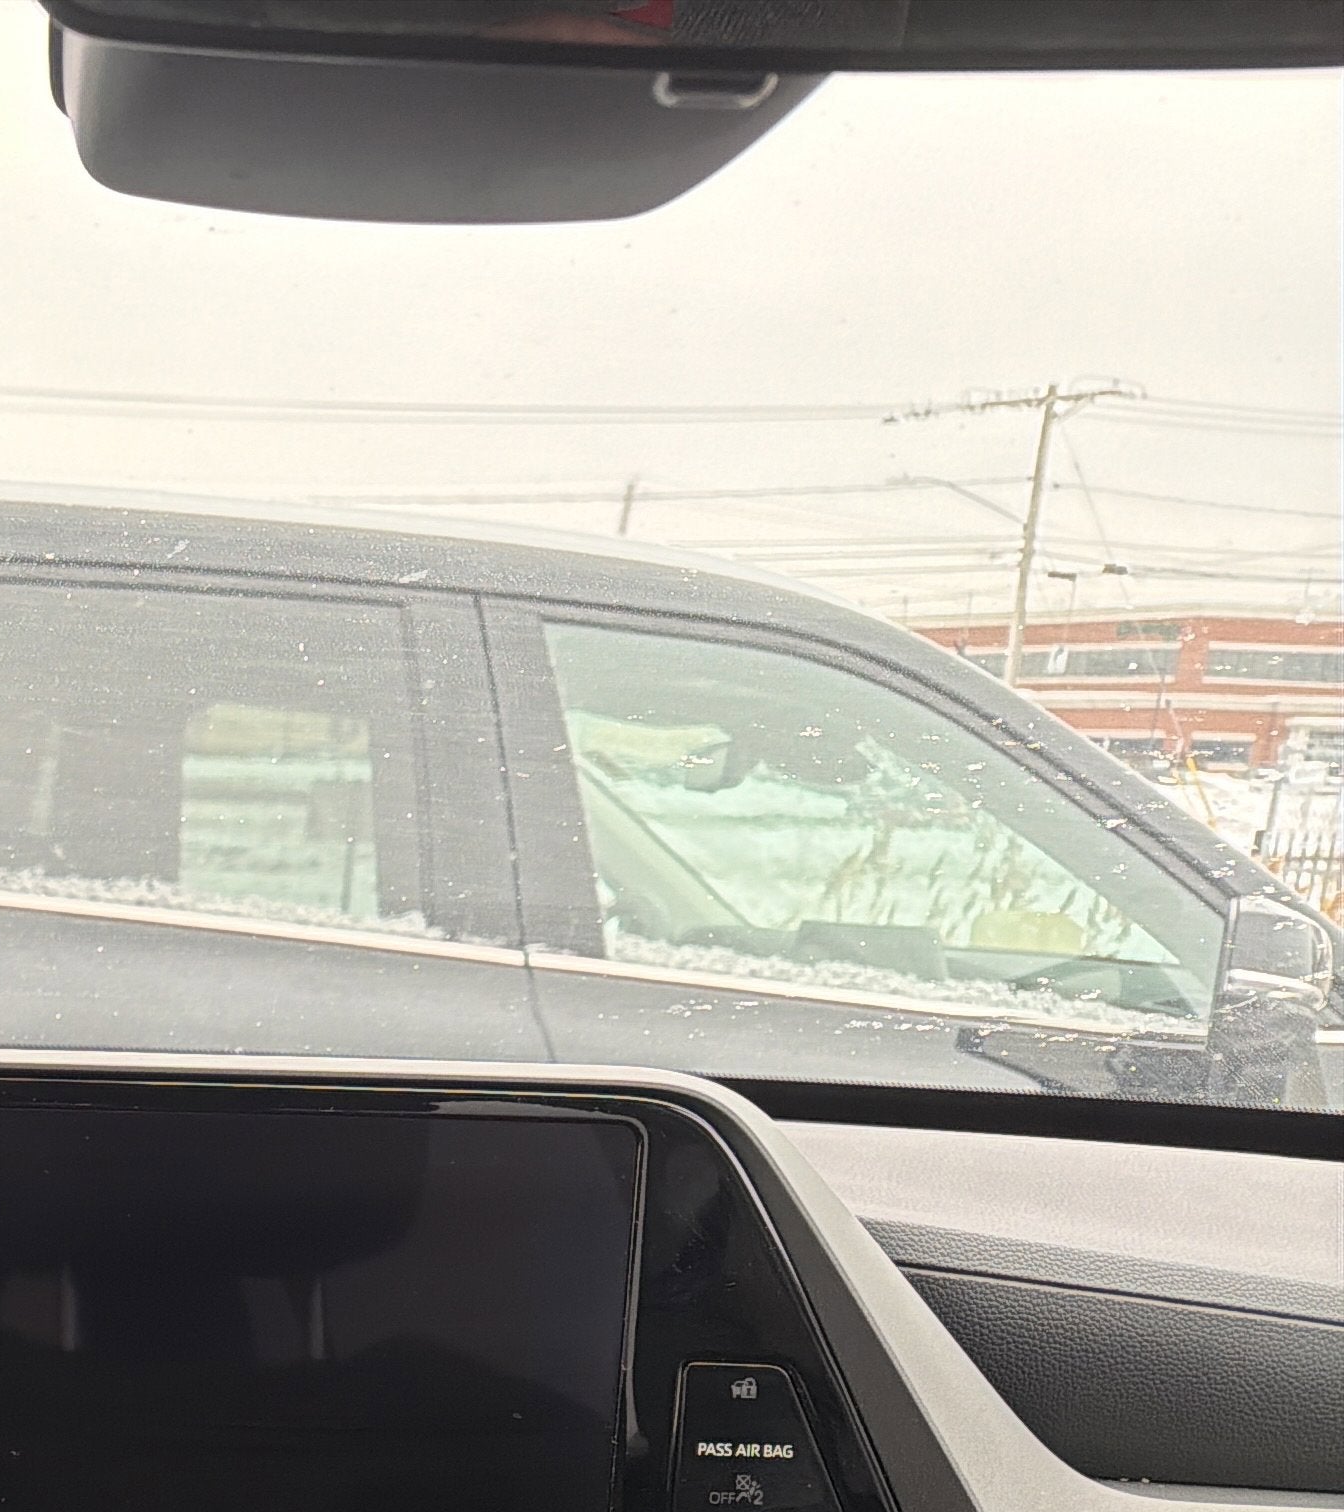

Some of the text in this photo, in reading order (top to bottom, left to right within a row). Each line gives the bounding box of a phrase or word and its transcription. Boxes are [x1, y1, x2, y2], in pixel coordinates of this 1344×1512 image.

[697, 1442, 794, 1458] PASS AIR BAG
[709, 1491, 736, 1505] OFF
